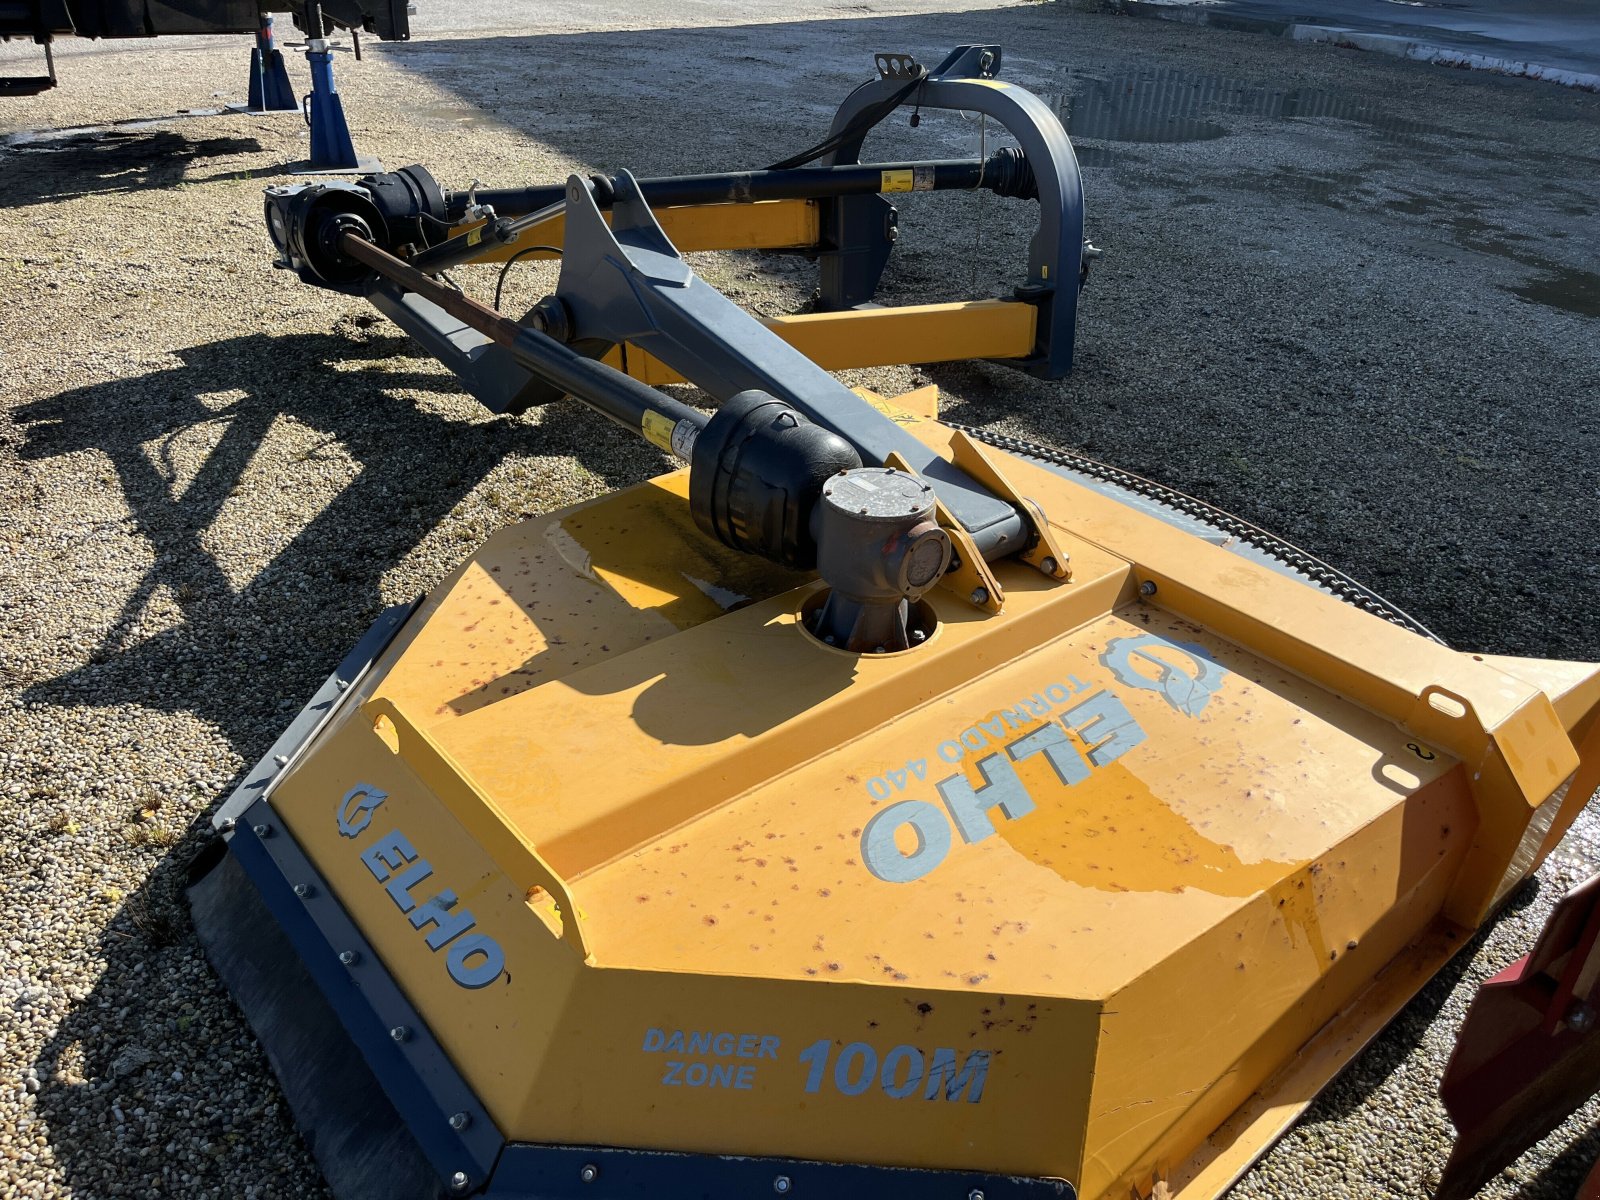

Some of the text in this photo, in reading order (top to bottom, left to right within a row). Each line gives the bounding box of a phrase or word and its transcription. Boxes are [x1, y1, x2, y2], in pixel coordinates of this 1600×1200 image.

[866, 673, 1092, 800] TORNADO 440
[860, 689, 1149, 883] ELHO
[360, 828, 505, 989] ELHO
[642, 1028, 780, 1060] DANGER
[662, 1061, 756, 1089] ZONE
[799, 1038, 991, 1104] 100M
